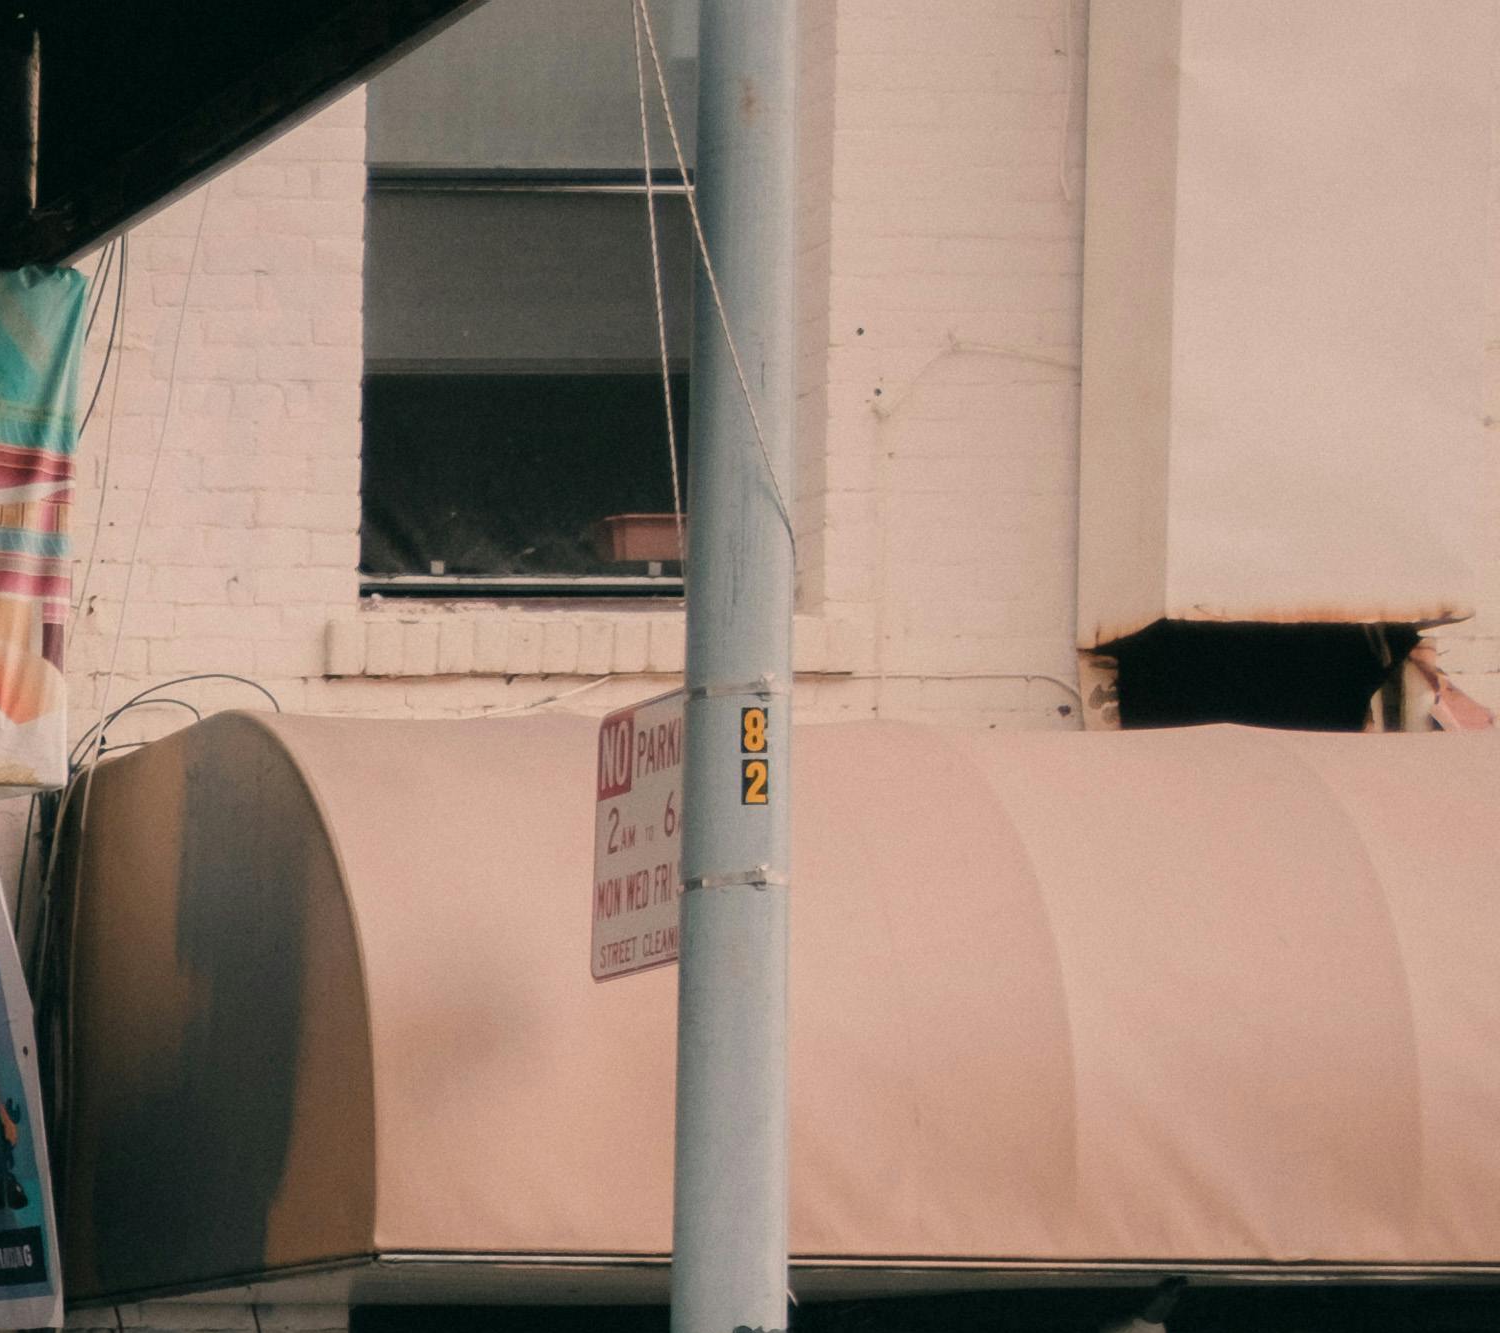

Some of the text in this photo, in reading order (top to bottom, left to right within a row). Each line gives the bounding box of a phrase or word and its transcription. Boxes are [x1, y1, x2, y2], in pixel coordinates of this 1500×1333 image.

[601, 717, 682, 791] NO PARKI
[597, 862, 672, 922] MON WED FRI
[600, 935, 638, 970] STREET
